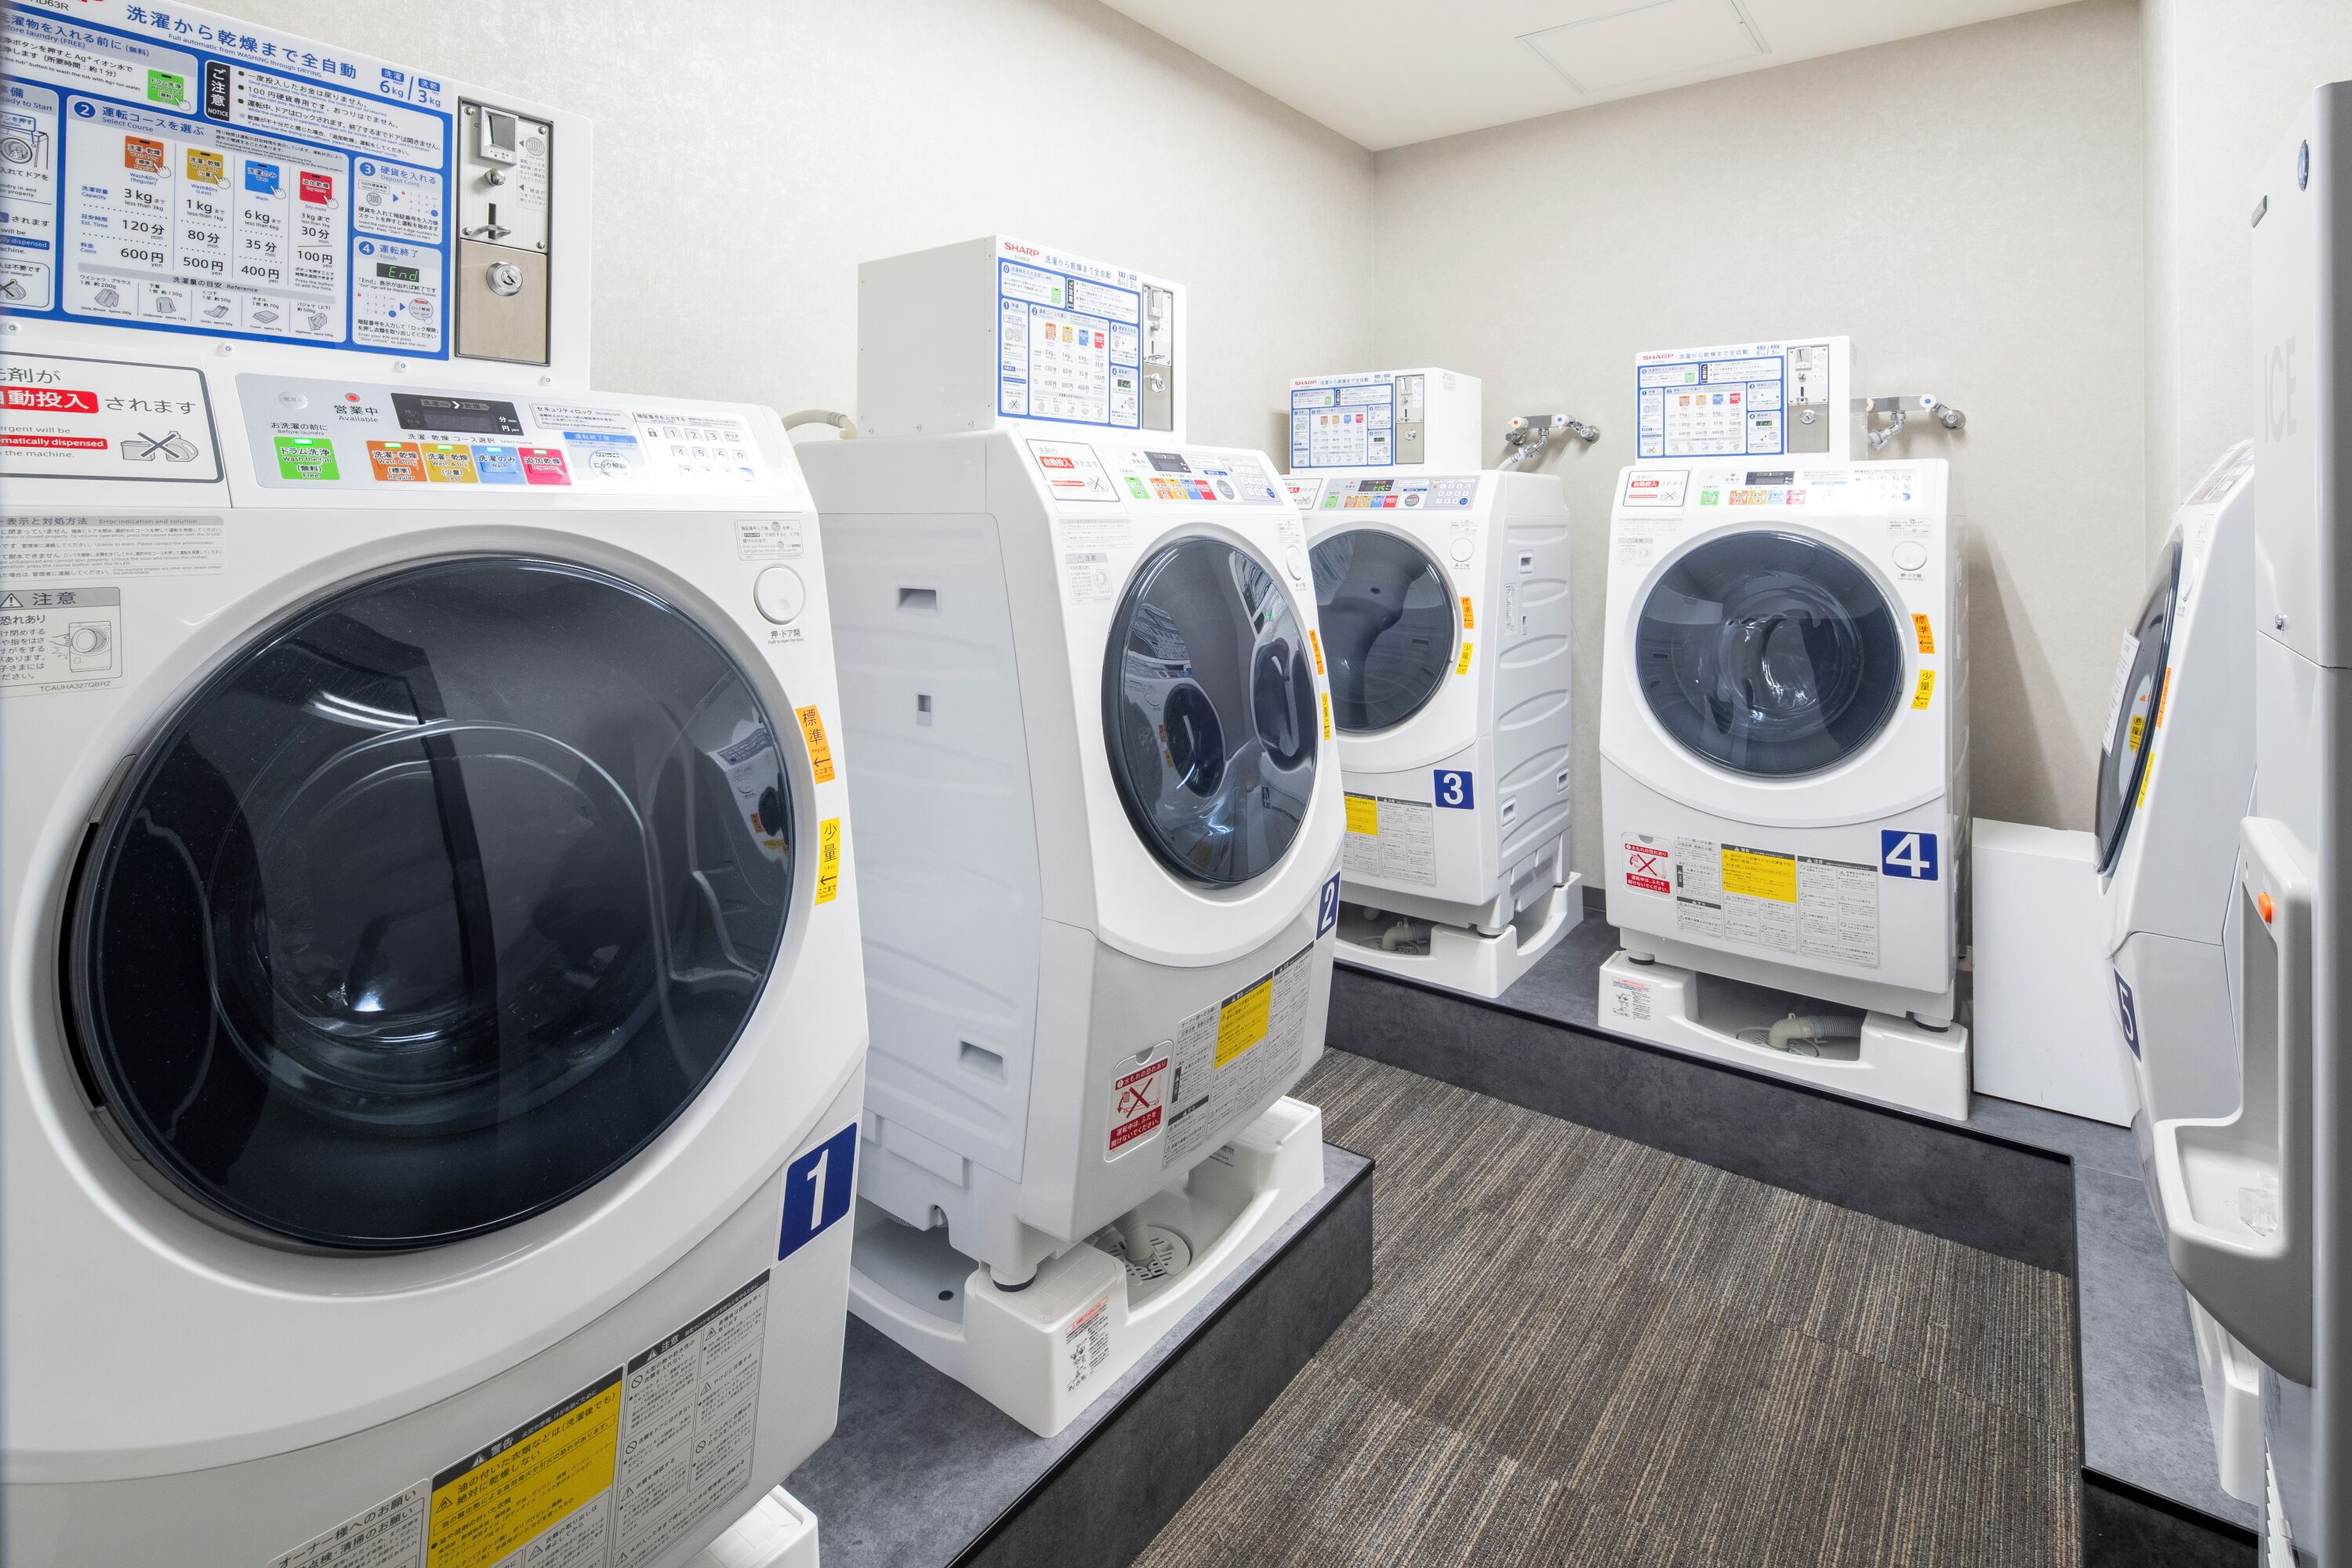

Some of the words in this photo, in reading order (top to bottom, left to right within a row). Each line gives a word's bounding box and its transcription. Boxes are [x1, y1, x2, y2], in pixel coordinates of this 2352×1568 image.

[27, 29, 59, 42] laundry
[60, 38, 85, 49] (FREE)
[127, 4, 357, 79] 洗濯から乾燥まで全自動
[183, 37, 218, 51] automatic
[220, 46, 235, 56] from
[238, 51, 269, 64] WASHING
[270, 60, 296, 71] through
[297, 66, 323, 78] DRYING.
[384, 68, 402, 80] 洗濯
[211, 68, 226, 107] ご注意
[247, 74, 368, 108] 一度投入したお金は戻りません。
[379, 80, 390, 93] 6
[392, 86, 404, 98] kg
[419, 89, 427, 103] 3
[430, 96, 441, 107] kg
[34, 101, 53, 111] Start
[81, 103, 90, 116] 2
[208, 107, 229, 118] NOTICE
[102, 106, 204, 136] 運転コースを選ぶ
[103, 117, 125, 127] Select
[127, 122, 154, 132] Course
[365, 164, 372, 173] 3
[380, 165, 437, 184] 硬貨を入れる
[130, 172, 158, 182] Wash&Dry
[130, 178, 157, 187] (Regular)
[381, 175, 403, 185] Deposit
[82, 186, 109, 195] 洗濯容量
[191, 183, 218, 193] Wash&Dry
[82, 191, 107, 201] Capacity
[124, 188, 132, 199] 3
[136, 190, 152, 204] kg
[187, 199, 192, 209] 1
[197, 201, 212, 214] kg
[12, 216, 50, 227] されます
[245, 209, 252, 220] 6
[256, 211, 270, 224] kg
[11, 238, 47, 249] dispensed
[363, 244, 370, 253] 4
[379, 244, 419, 258] 運転終了
[1004, 241, 1040, 256] SHARP
[389, 266, 418, 281] End
[1045, 254, 1112, 280] 洗濯から乾燥まで全自動
[172, 276, 222, 289] 洗濯量の目安
[227, 283, 259, 293] Reference
[0, 389, 90, 410] 動投入
[105, 397, 196, 415] されます
[333, 405, 379, 416] 営業中
[536, 406, 592, 415] セキュリティロック
[271, 422, 328, 431] お洗濯の前に
[51, 437, 104, 448] dispensed
[453, 436, 495, 445] コース選択
[27, 450, 75, 459] machine.
[281, 447, 331, 456] ドラム洗浄
[477, 454, 515, 463] 洗濯のみ
[525, 457, 561, 466] 追加乾燥
[1044, 458, 1073, 467] 自動投入
[32, 592, 76, 606] 注意
[1915, 615, 1928, 634] 標準
[1920, 671, 1933, 691] 少量
[803, 709, 823, 745] 標準
[815, 765, 833, 775] ここまで
[1443, 772, 1464, 805] 3
[823, 822, 838, 863] 少量
[1886, 833, 1930, 877] 4
[818, 884, 837, 895] ここまで
[1321, 881, 1335, 931] 2
[2119, 982, 2133, 1041] 5
[1123, 1062, 1166, 1085] 水もれの恐れあり
[1116, 1111, 1156, 1136] 運転中は、ふたを
[1111, 1119, 1160, 1148] 開けないでください。
[807, 1149, 829, 1231] 1
[661, 1334, 680, 1352] 注意
[491, 1436, 514, 1457] 警告
[456, 1450, 540, 1506] 絶対に乾燥しない
[279, 1490, 416, 1568] オーナー様へのお願い
